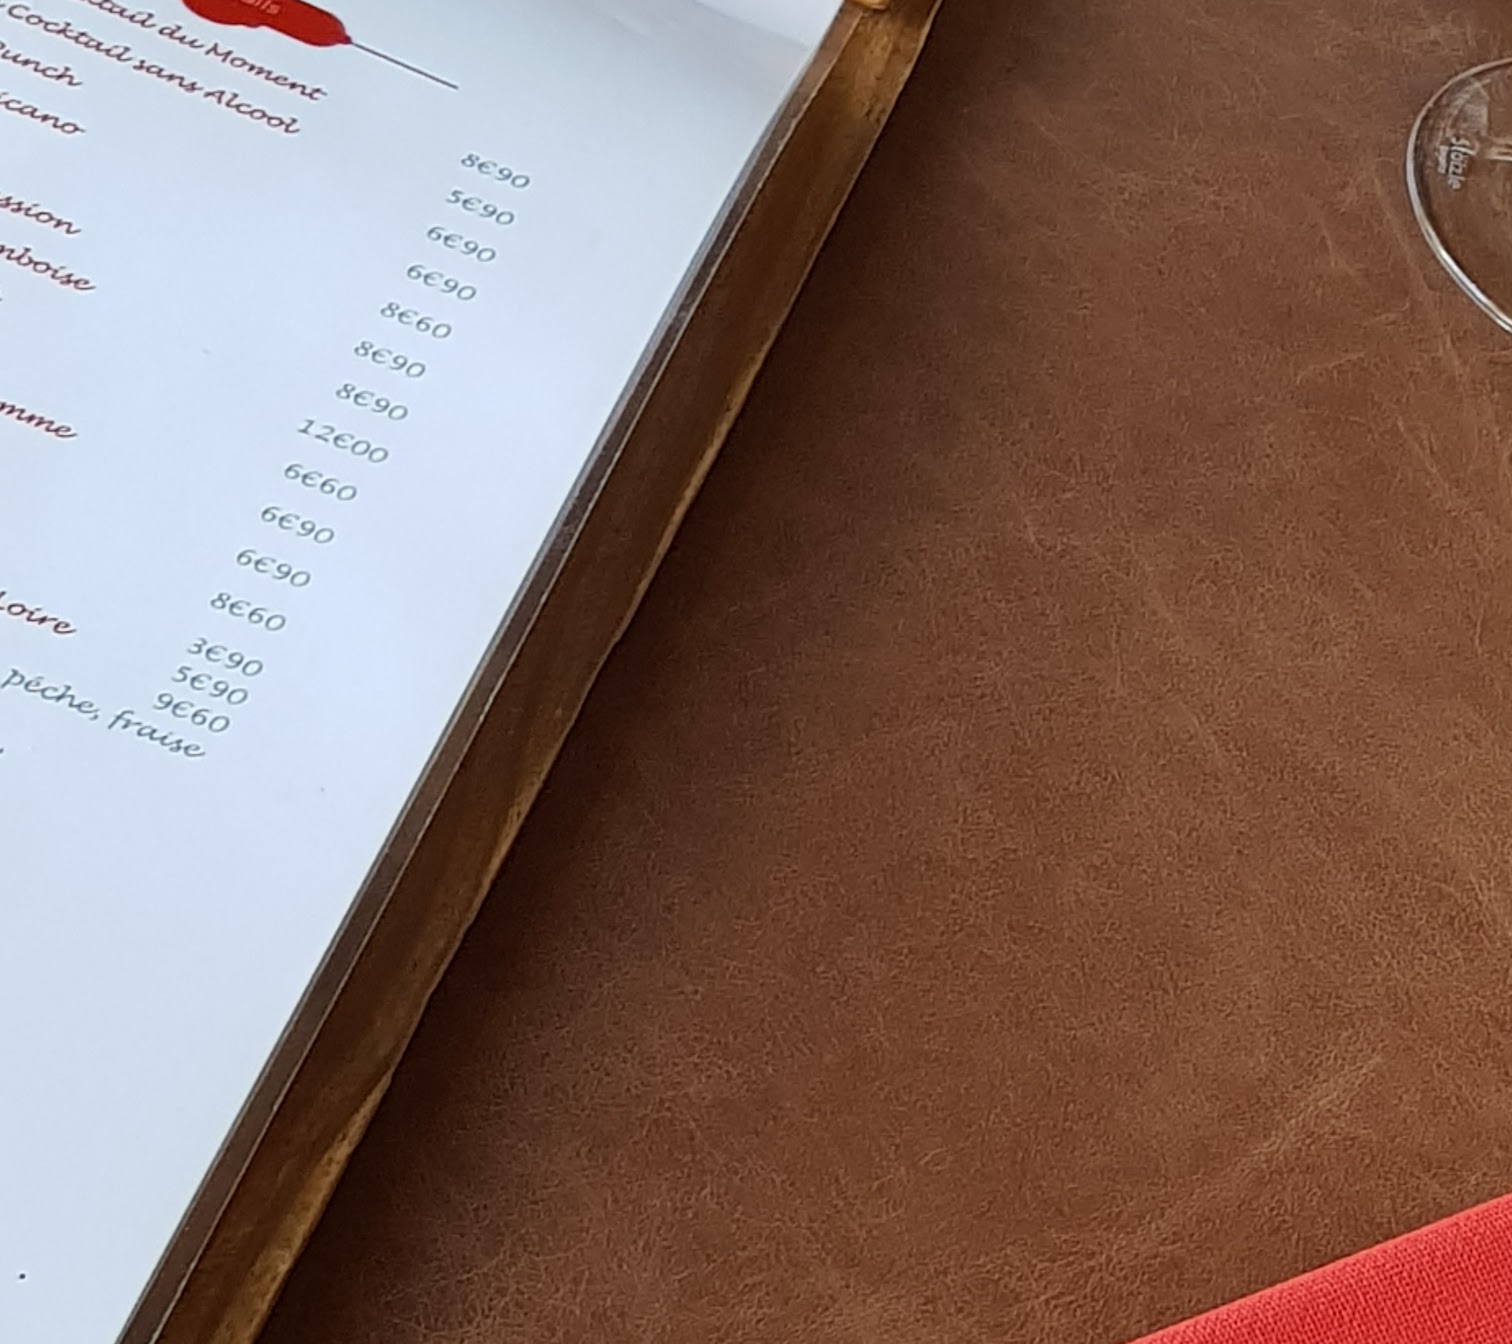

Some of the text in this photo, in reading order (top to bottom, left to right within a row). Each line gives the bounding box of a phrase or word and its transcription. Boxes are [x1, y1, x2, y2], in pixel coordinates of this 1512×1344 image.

[0, 41, 83, 87] unch
[7, 3, 301, 135] Cocktail sans Alcool
[158, 23, 206, 50] du
[203, 41, 329, 101] Moment
[460, 152, 531, 190] 8€90
[445, 188, 516, 227] 5€90
[426, 226, 497, 264] 6€90
[406, 263, 478, 302] 6€90
[379, 301, 453, 340] 8€60
[353, 340, 427, 379] 8€90
[335, 383, 409, 422] 8€90
[297, 418, 390, 464] 12€00
[283, 463, 358, 502] 6€60
[260, 506, 335, 545] 6€90
[236, 548, 311, 588] 6€90
[210, 592, 287, 632] 8€60
[187, 637, 264, 677] 3€90
[170, 665, 249, 706] 5€90
[152, 692, 231, 733] 9€60
[107, 709, 207, 758] fraise
